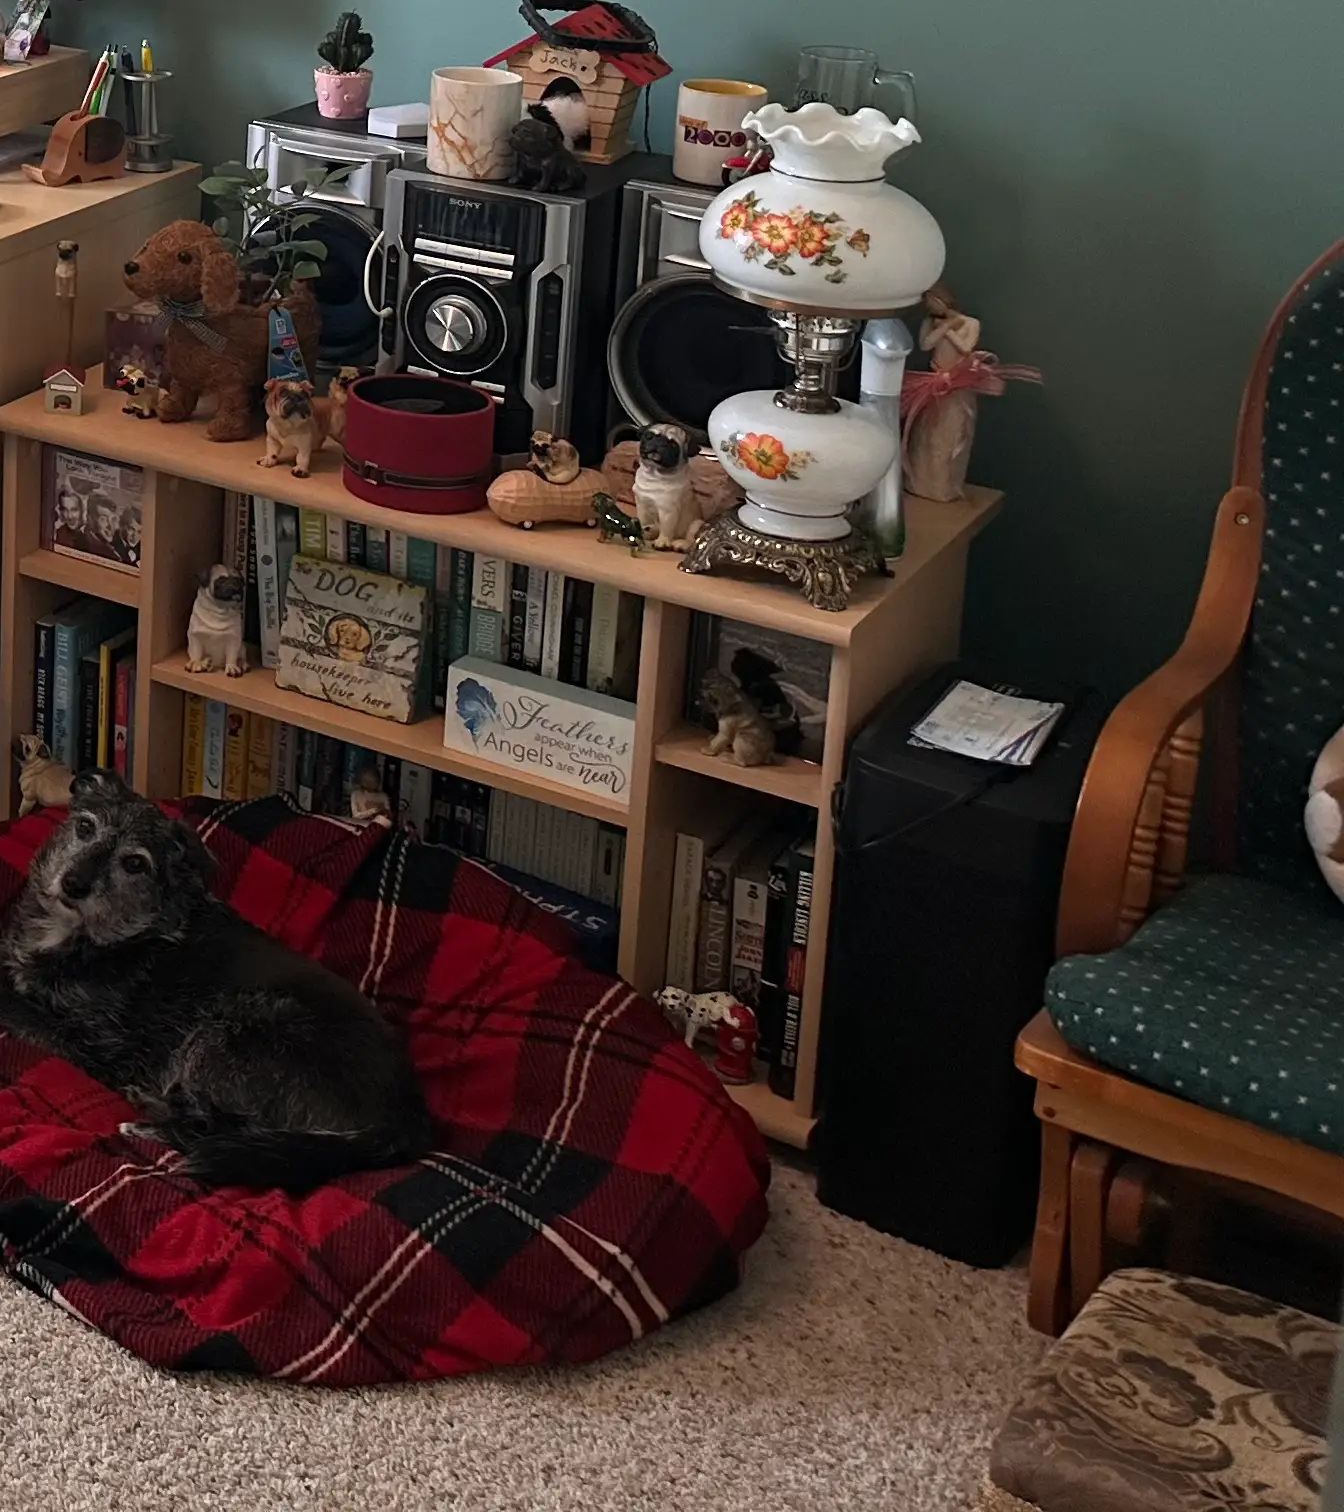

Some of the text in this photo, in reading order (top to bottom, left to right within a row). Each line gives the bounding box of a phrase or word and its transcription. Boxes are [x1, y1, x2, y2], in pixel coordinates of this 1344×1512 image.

[539, 49, 578, 72] Jack
[683, 124, 747, 148] 2000
[448, 197, 483, 210] SONY
[58, 454, 91, 469] The Way
[312, 515, 329, 541] TIM
[314, 567, 380, 602] DOG
[56, 632, 69, 661] BILL
[474, 615, 496, 655] BRIDGE
[512, 615, 523, 661] GIVER
[291, 652, 372, 685] housekeeper
[55, 665, 69, 709] GEIST
[329, 682, 392, 709] live here
[503, 695, 629, 757] Feathers
[483, 732, 627, 793] Angels are near
[534, 732, 613, 763] appear when
[792, 870, 813, 946] KILLING LINCOLN
[703, 909, 730, 988] LINCOLN
